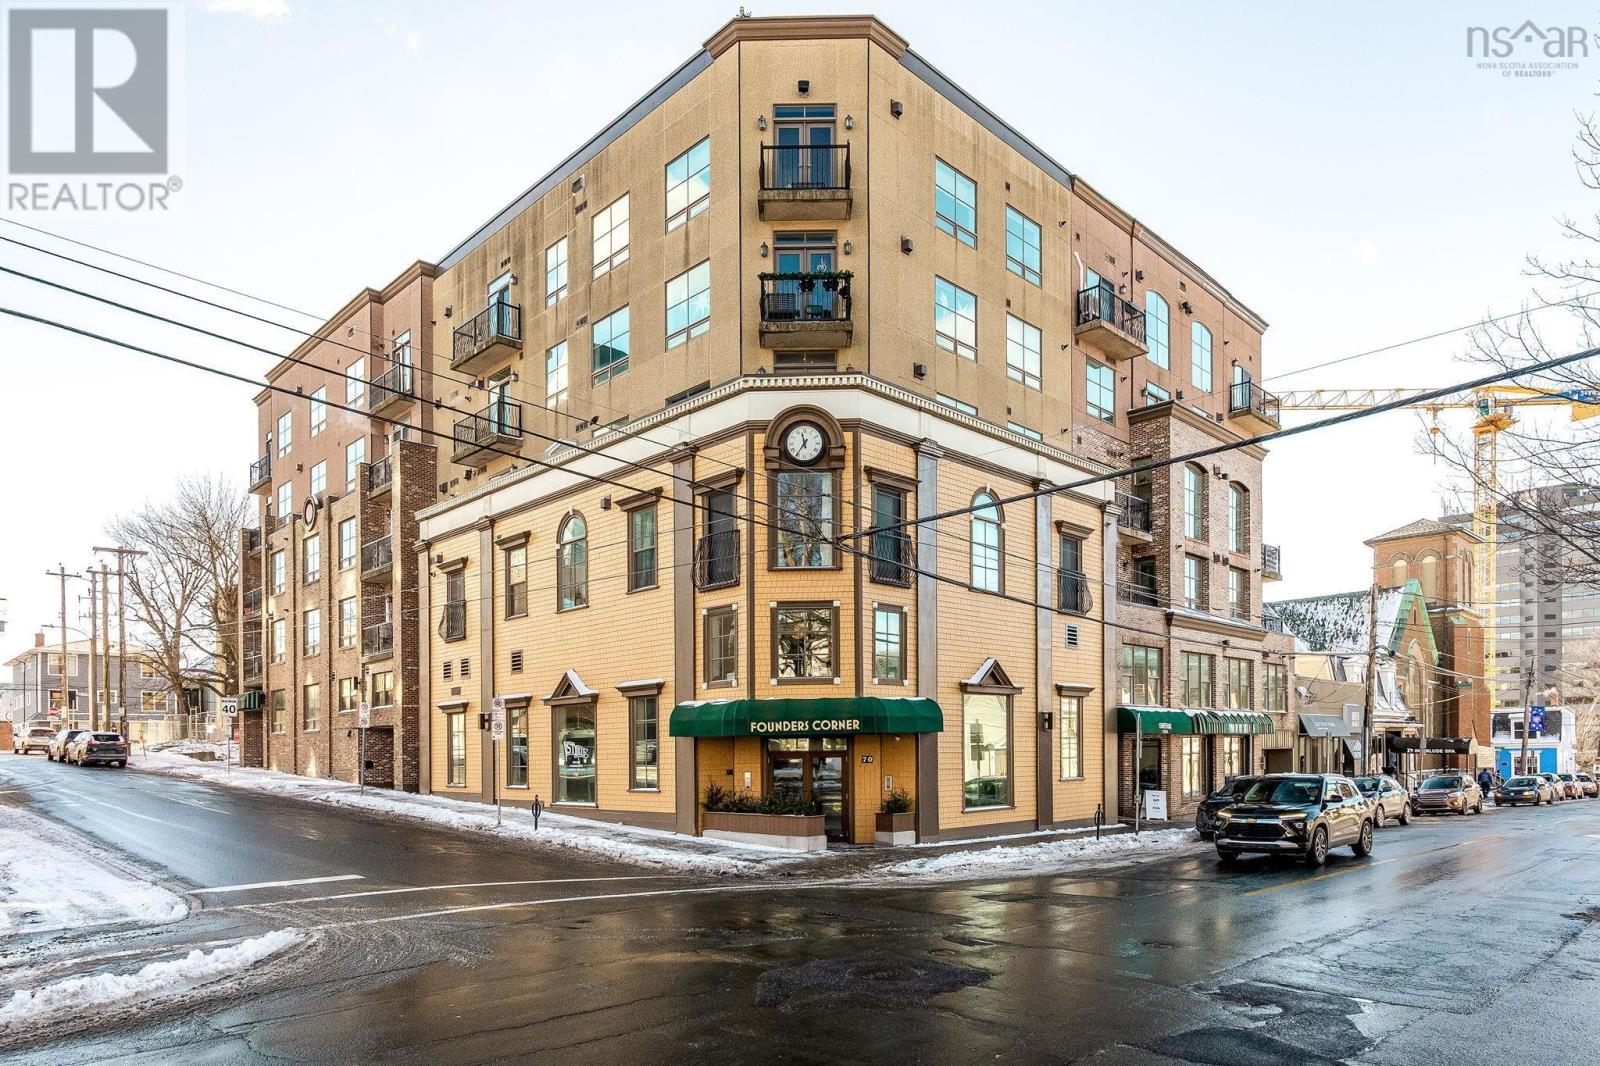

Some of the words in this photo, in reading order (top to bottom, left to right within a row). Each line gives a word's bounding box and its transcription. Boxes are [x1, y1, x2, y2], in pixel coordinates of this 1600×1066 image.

[222, 705, 236, 713] 40
[750, 720, 809, 733] FOUNDERS
[812, 719, 860, 731] CORNER
